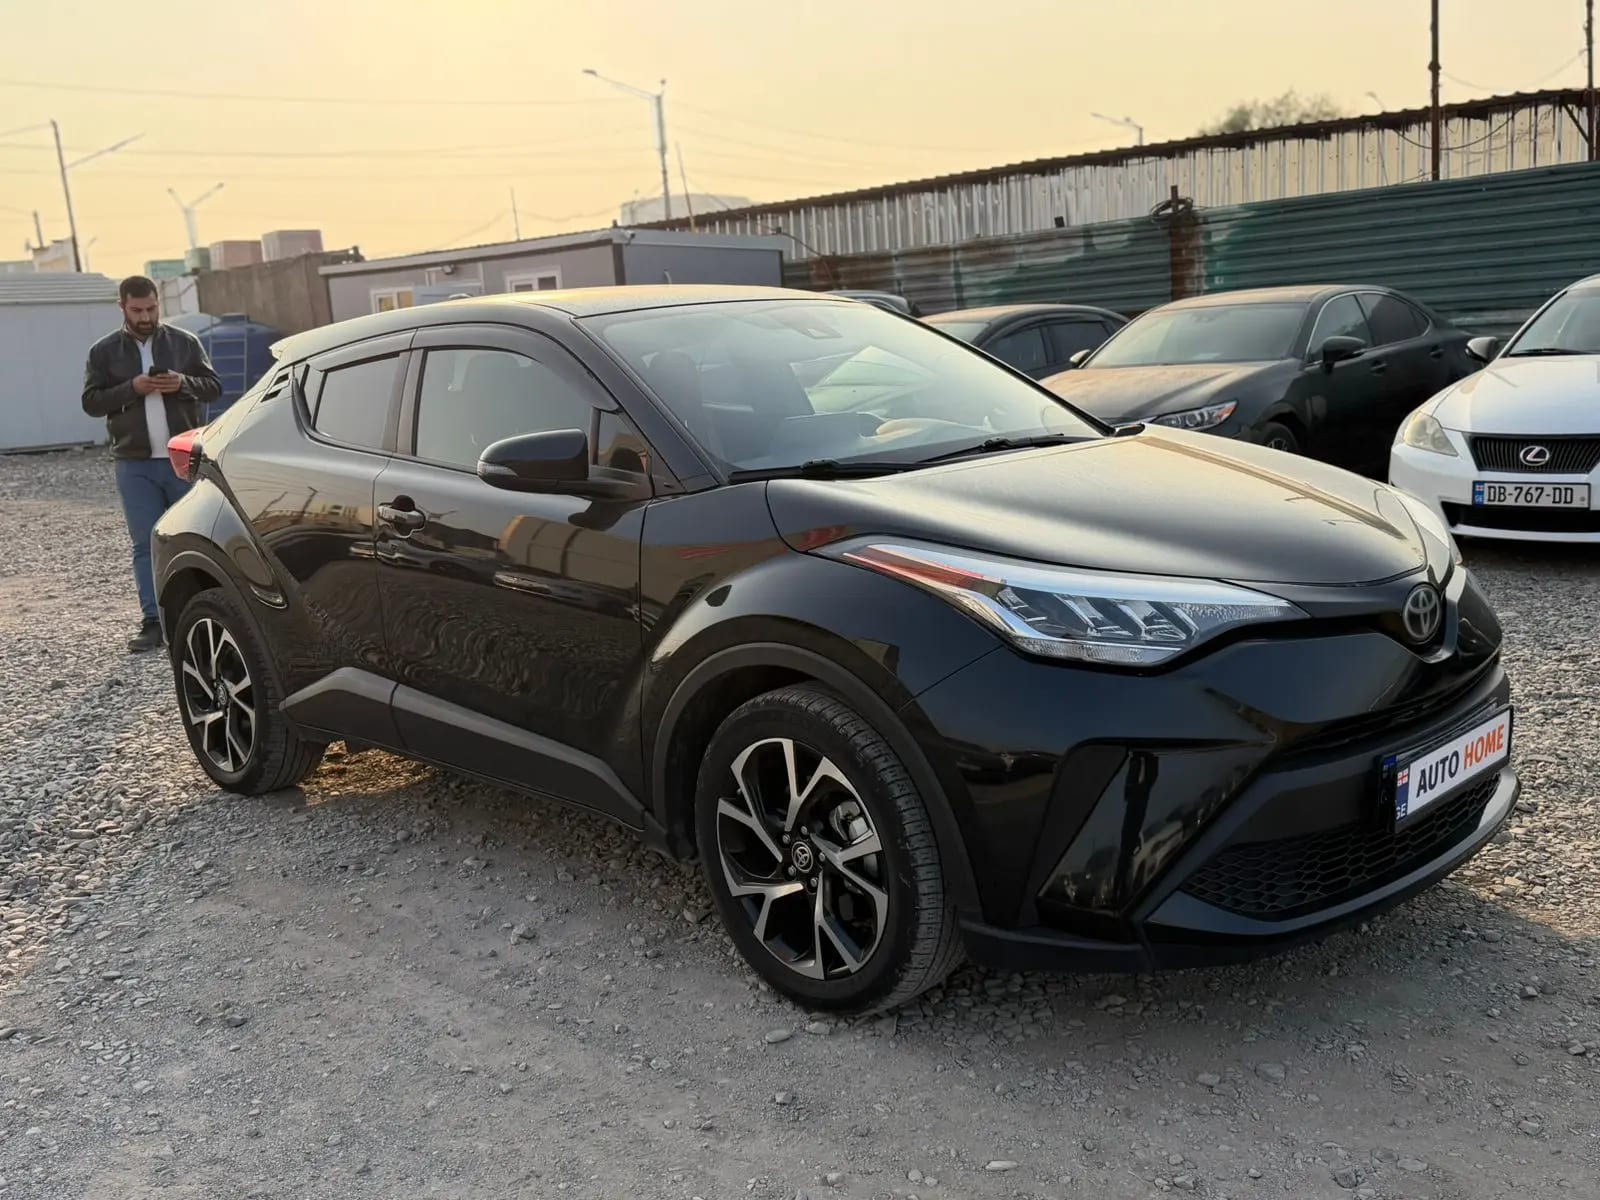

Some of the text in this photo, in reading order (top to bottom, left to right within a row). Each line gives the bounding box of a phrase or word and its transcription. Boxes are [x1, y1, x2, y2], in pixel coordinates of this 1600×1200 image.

[1487, 485, 1574, 504] DB-767-DD
[1416, 724, 1504, 798] AUTO HOME
